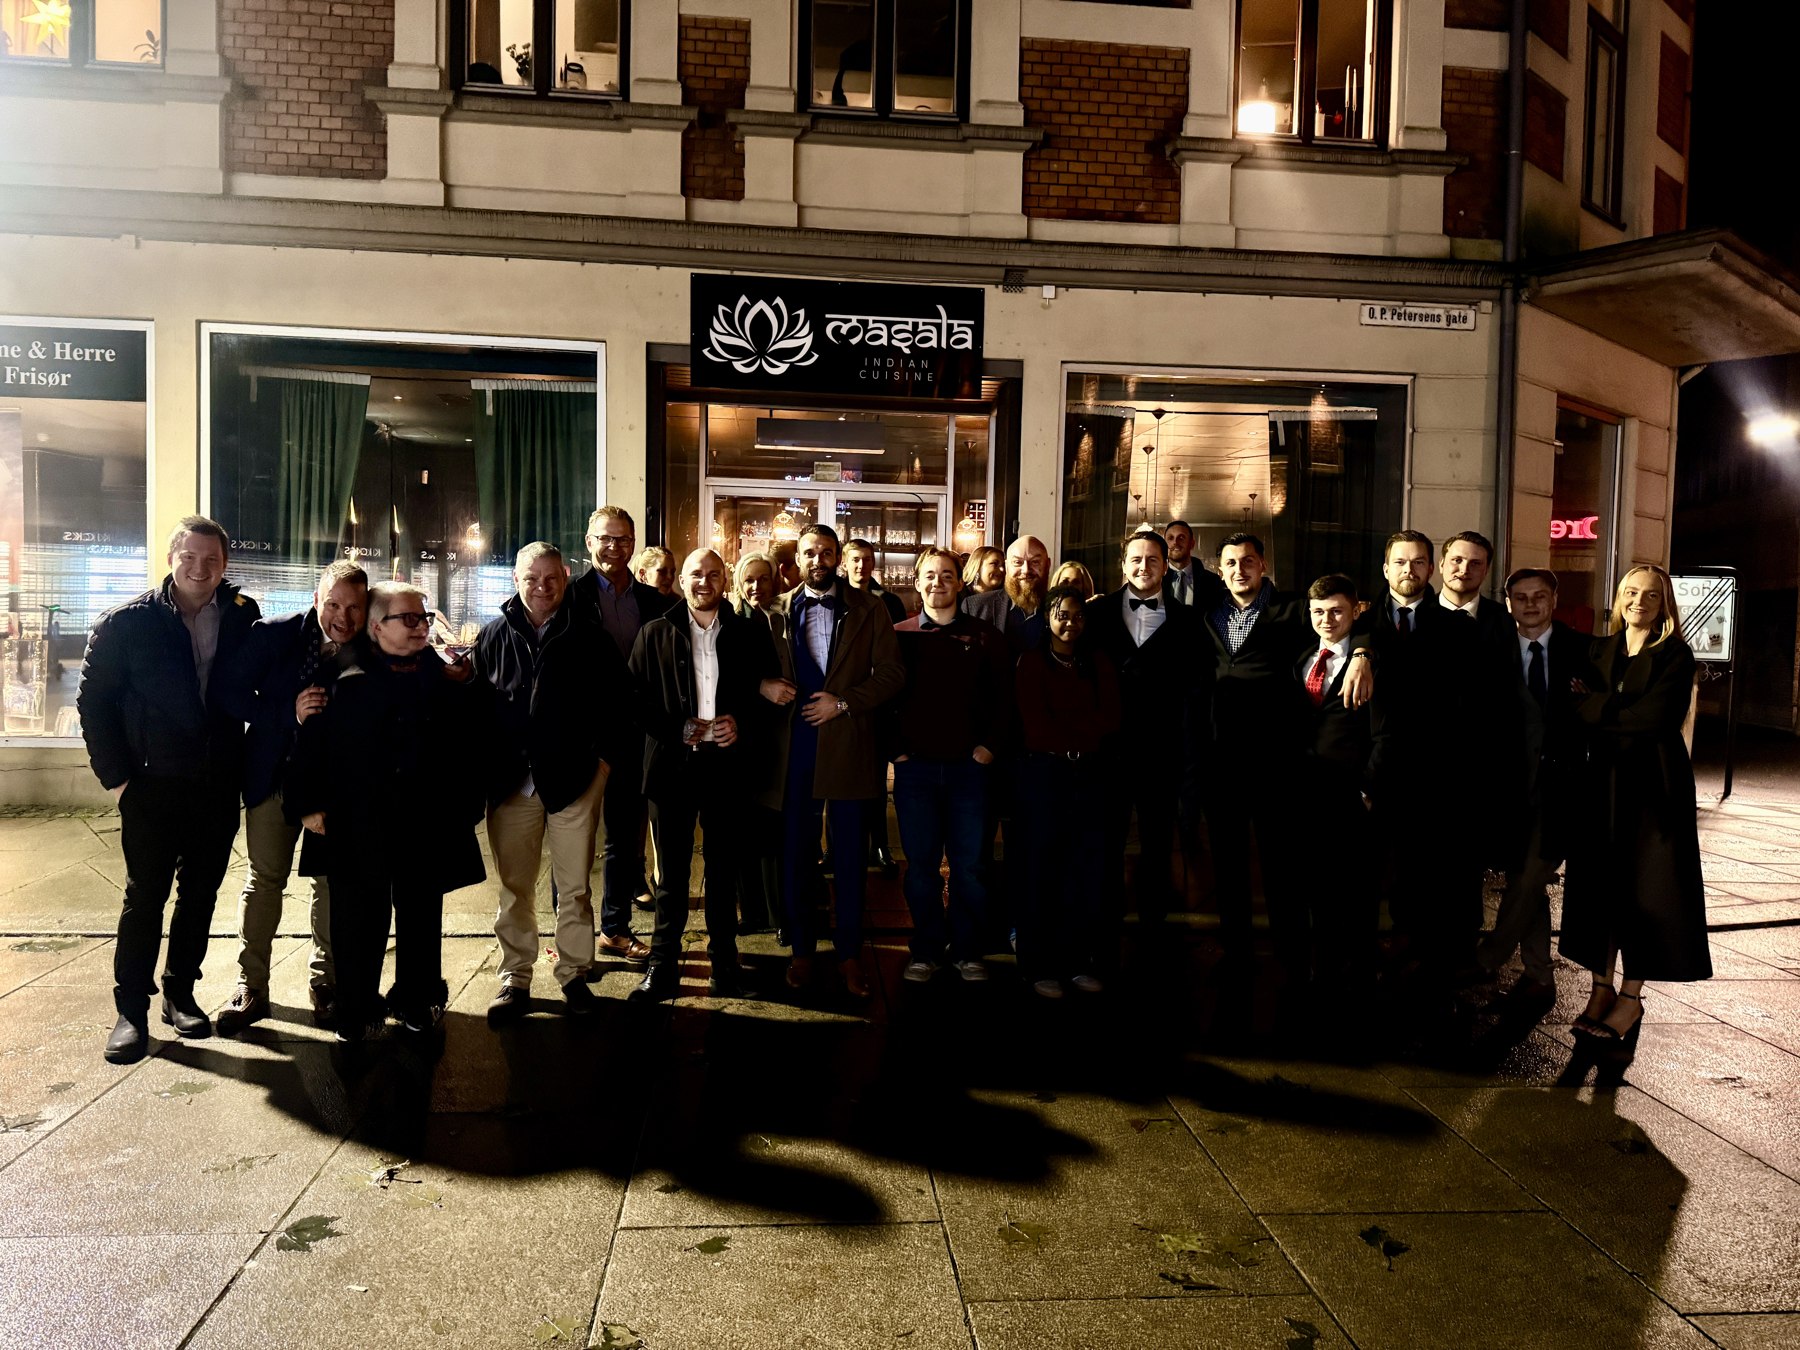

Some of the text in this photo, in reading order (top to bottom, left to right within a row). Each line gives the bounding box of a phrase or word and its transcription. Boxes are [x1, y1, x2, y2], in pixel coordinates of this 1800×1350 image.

[1380, 307, 1388, 321] P.
[1391, 308, 1442, 323] Petersens
[1446, 311, 1468, 327] gate
[825, 304, 976, 355] masala
[27, 340, 47, 360] &
[53, 342, 116, 362] Herre
[864, 357, 929, 370] INDIAN
[4, 366, 72, 388] Frisør
[859, 370, 934, 382] CUISINE
